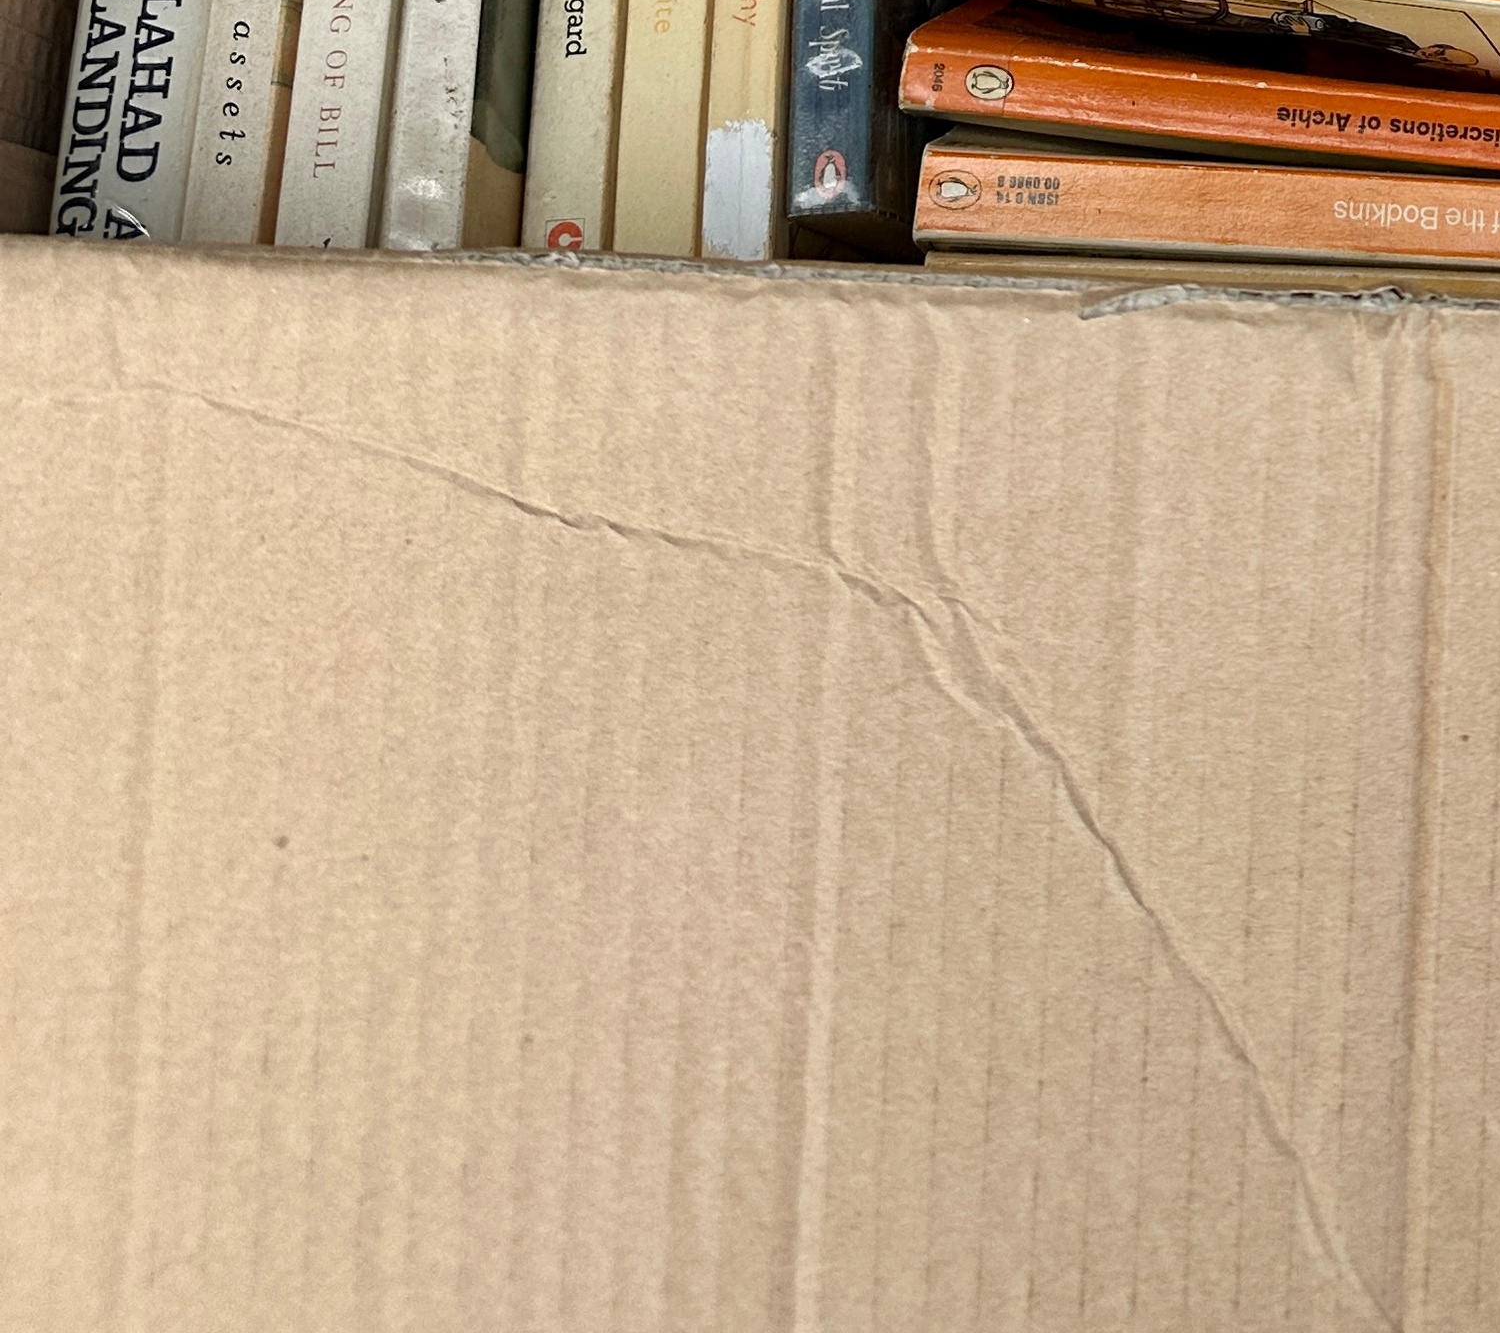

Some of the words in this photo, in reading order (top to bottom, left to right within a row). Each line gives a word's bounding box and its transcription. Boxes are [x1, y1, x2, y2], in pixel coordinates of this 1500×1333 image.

[324, 50, 348, 90] OF
[931, 62, 945, 93] 2046
[215, 20, 251, 167] assets
[1276, 107, 1351, 130] Archie
[312, 106, 343, 179] BILL
